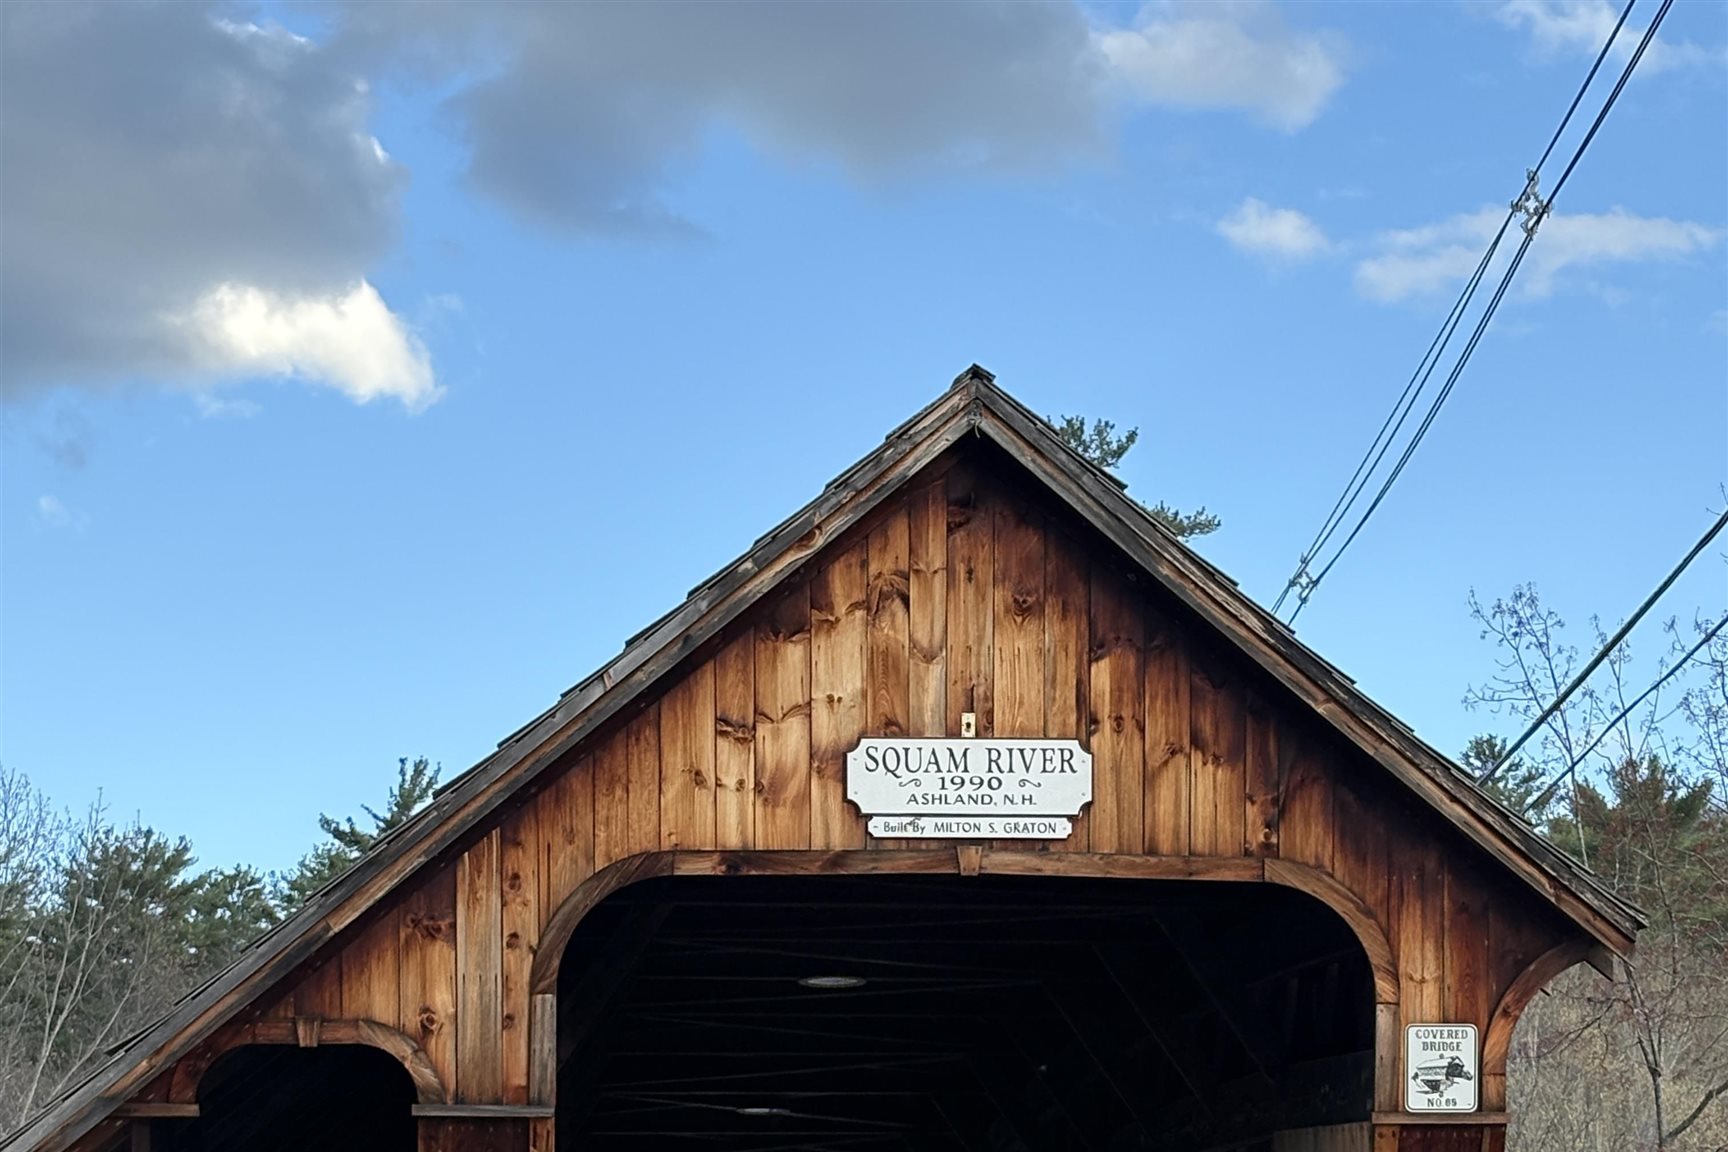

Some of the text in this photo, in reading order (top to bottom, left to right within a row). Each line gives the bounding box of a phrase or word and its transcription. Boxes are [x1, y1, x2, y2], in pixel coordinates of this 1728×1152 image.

[864, 746, 1078, 778] SQUAM RIVER
[938, 776, 1003, 791] 1990
[912, 821, 926, 835] By
[933, 822, 982, 833] MILTON
[989, 822, 998, 833] S.
[1003, 822, 1057, 834] GRATON
[1415, 1029, 1468, 1040] COVERED
[1422, 1041, 1462, 1051] BRIDGE
